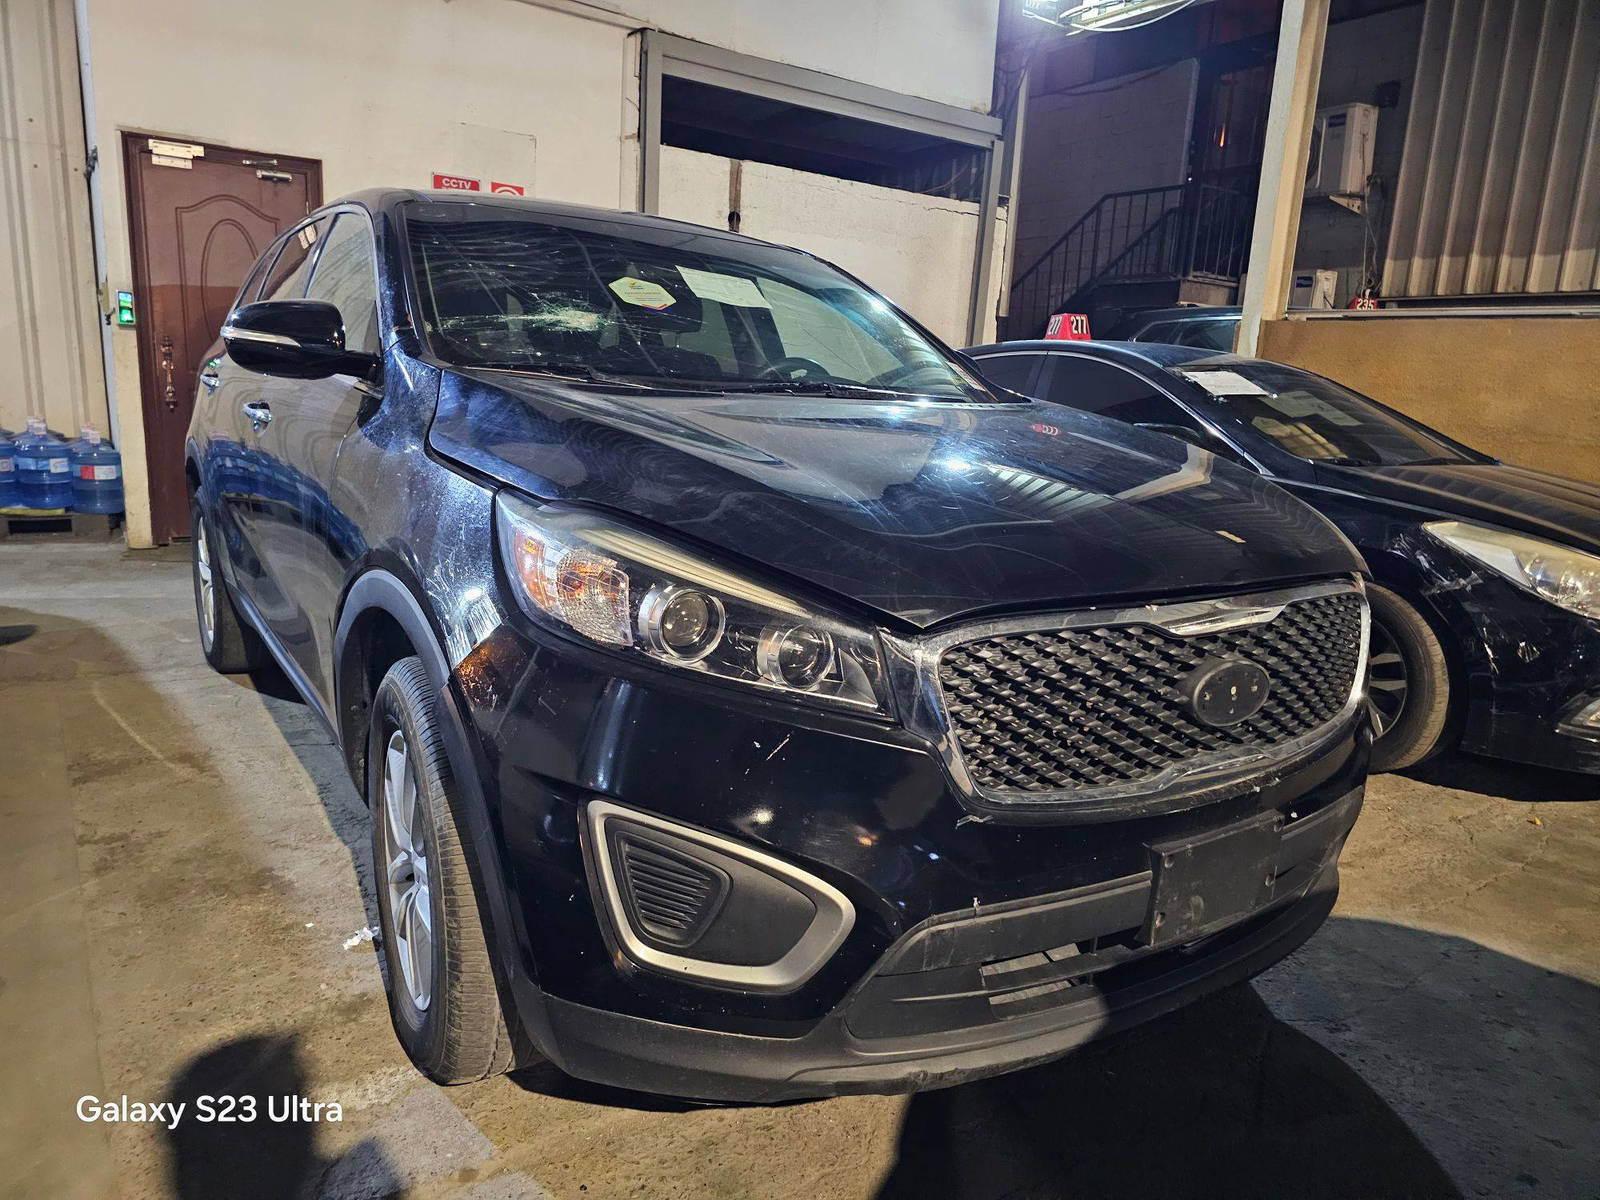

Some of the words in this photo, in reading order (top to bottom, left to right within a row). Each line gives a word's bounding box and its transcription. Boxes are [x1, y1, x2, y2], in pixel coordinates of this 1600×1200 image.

[442, 177, 471, 190] CCTV
[1356, 298, 1375, 310] 235
[1070, 315, 1087, 335] 277
